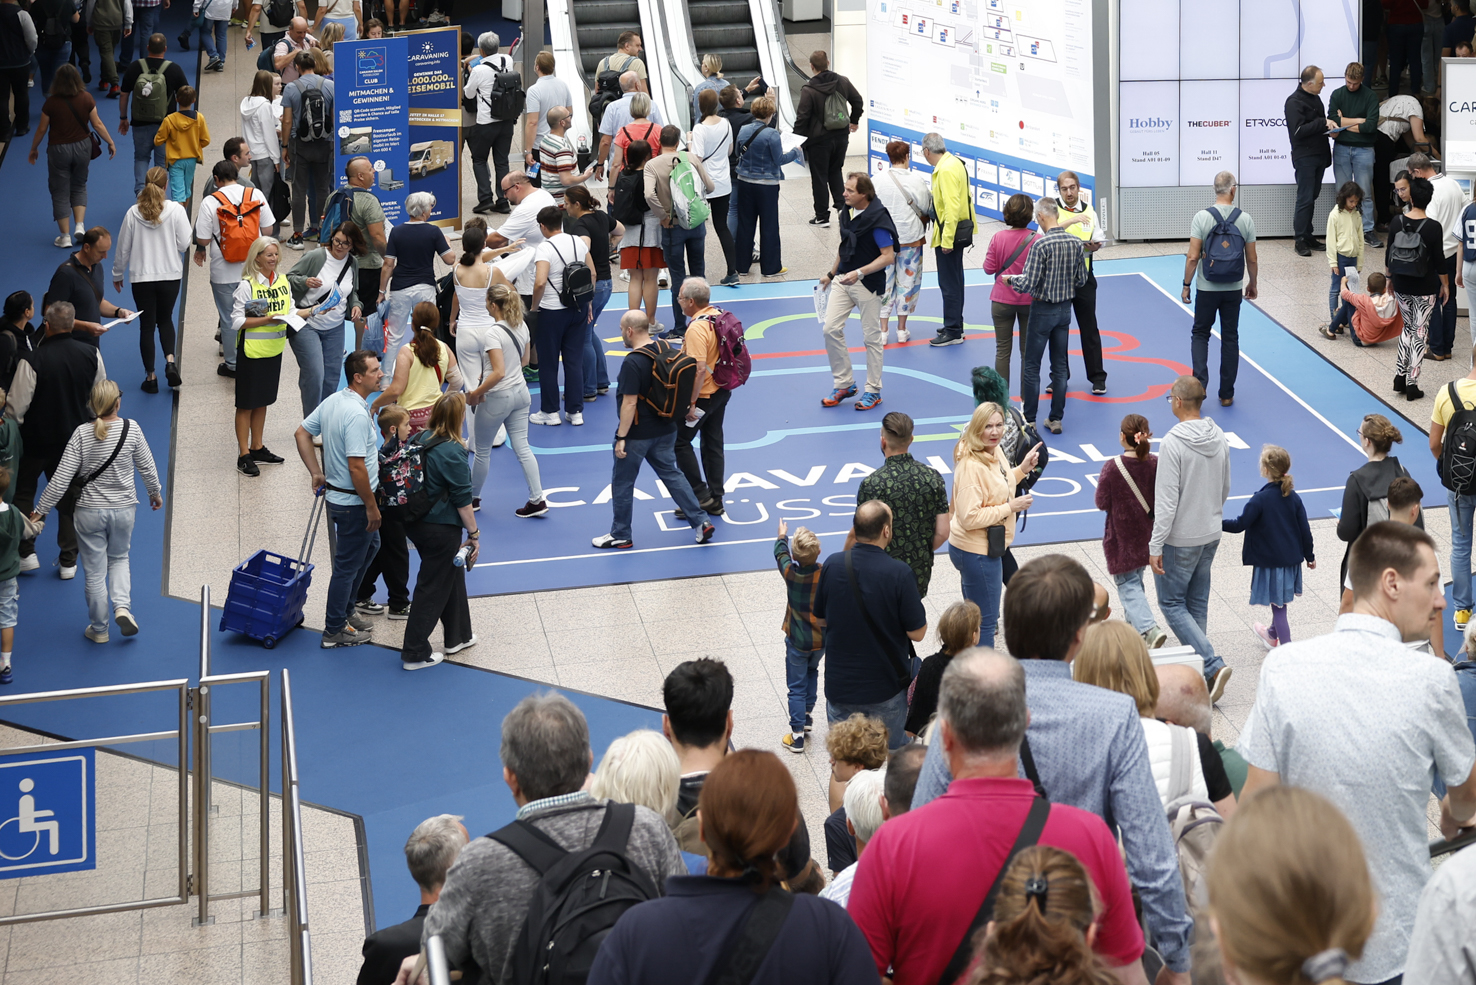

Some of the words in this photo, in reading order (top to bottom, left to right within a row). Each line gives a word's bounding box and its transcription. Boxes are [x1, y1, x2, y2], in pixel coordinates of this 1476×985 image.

[348, 88, 388, 97] MITMACHEN
[408, 81, 456, 94] EISEMOBIL
[353, 95, 390, 105] GEWINNEN!
[1129, 117, 1173, 130] Hobby
[1187, 120, 1230, 128] THECUBER
[278, 285, 288, 296] TO
[267, 299, 285, 312] HELP
